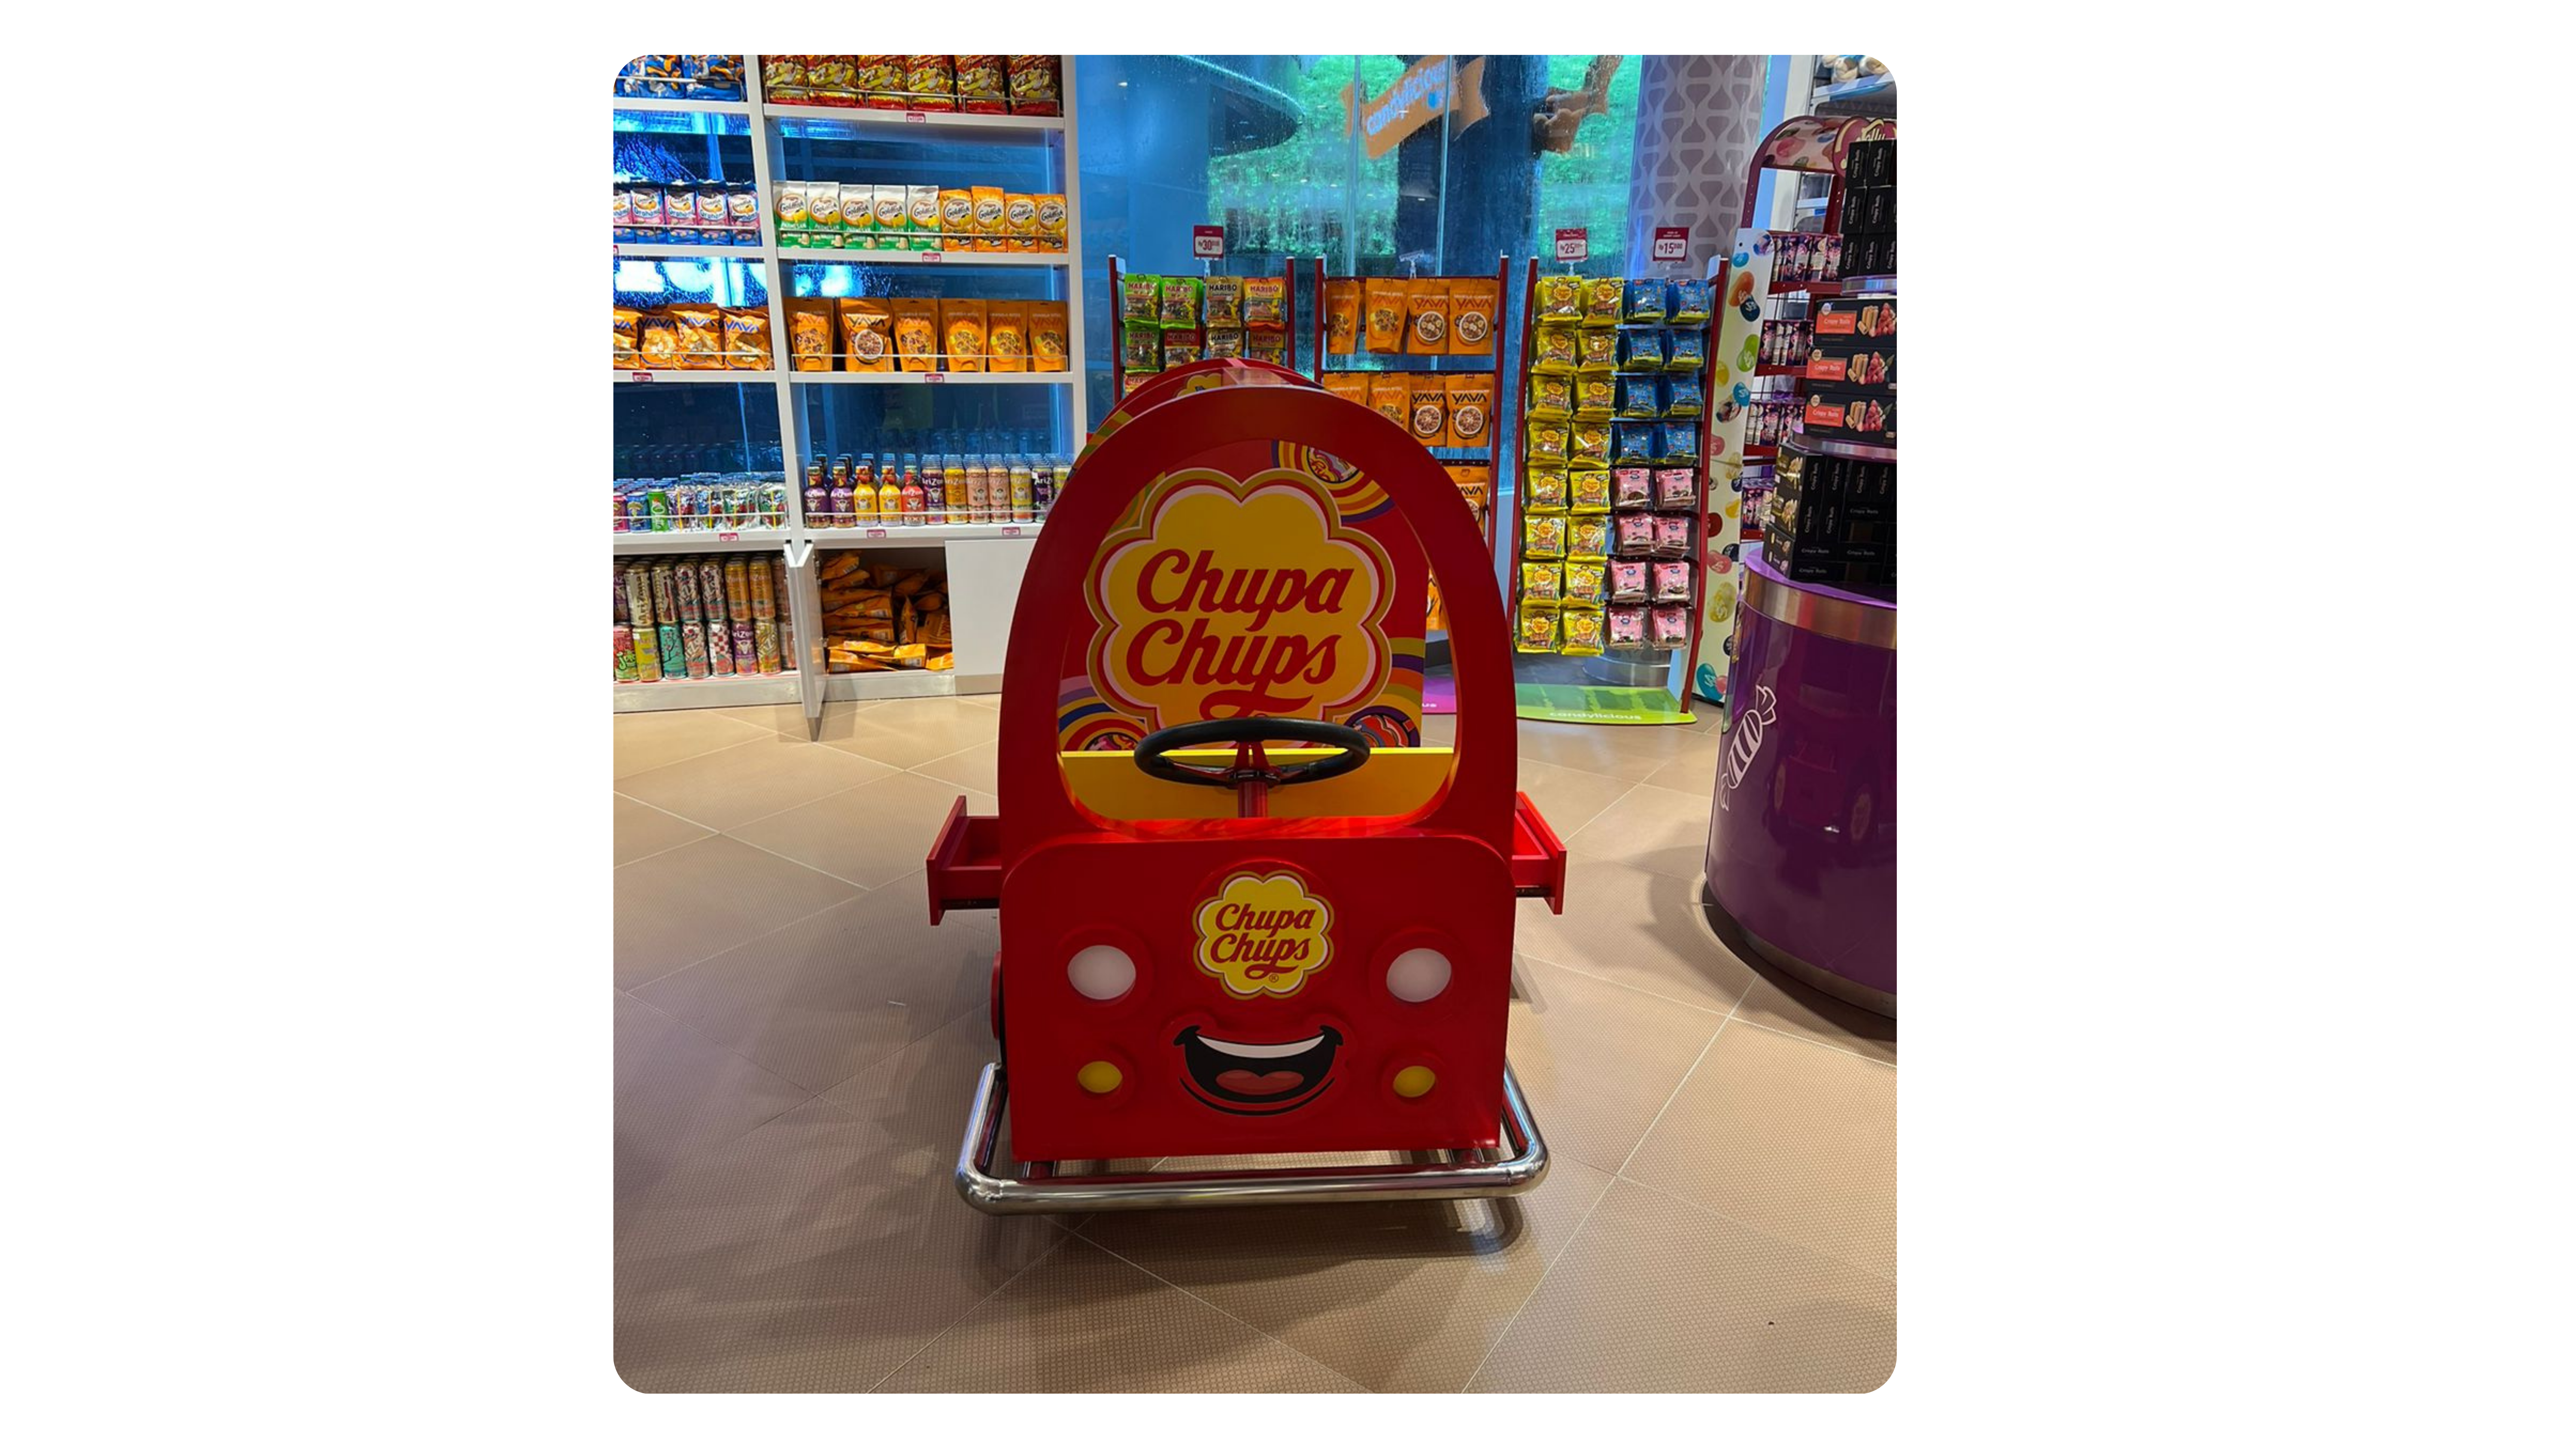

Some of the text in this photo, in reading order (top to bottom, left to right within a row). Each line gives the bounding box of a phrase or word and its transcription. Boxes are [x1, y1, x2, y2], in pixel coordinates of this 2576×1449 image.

[780, 201, 804, 212] Goldfish
[845, 204, 869, 215] Goldfish
[878, 205, 903, 216] Goldfish
[914, 206, 936, 217] Goldfish
[947, 206, 970, 217] Goldfish
[978, 207, 1002, 219] Goldfish
[1011, 207, 1033, 219] Goldfish
[1041, 209, 1063, 221] Goldfish
[1250, 285, 1279, 293] HARIBO
[1413, 299, 1448, 309] YAVA
[1456, 299, 1491, 309] YAVA
[1211, 333, 1239, 342] HARIBO
[1253, 334, 1281, 343] HARIBO
[1412, 393, 1445, 404] YAVA
[1452, 393, 1487, 404] YAVA
[1813, 409, 1826, 417] Crispy
[1136, 549, 1354, 632] Chupa
[1126, 619, 1342, 720] Chups
[1549, 711, 1642, 720] candylicious
[1215, 903, 1316, 938] Chupa
[1210, 933, 1311, 980] Chups
